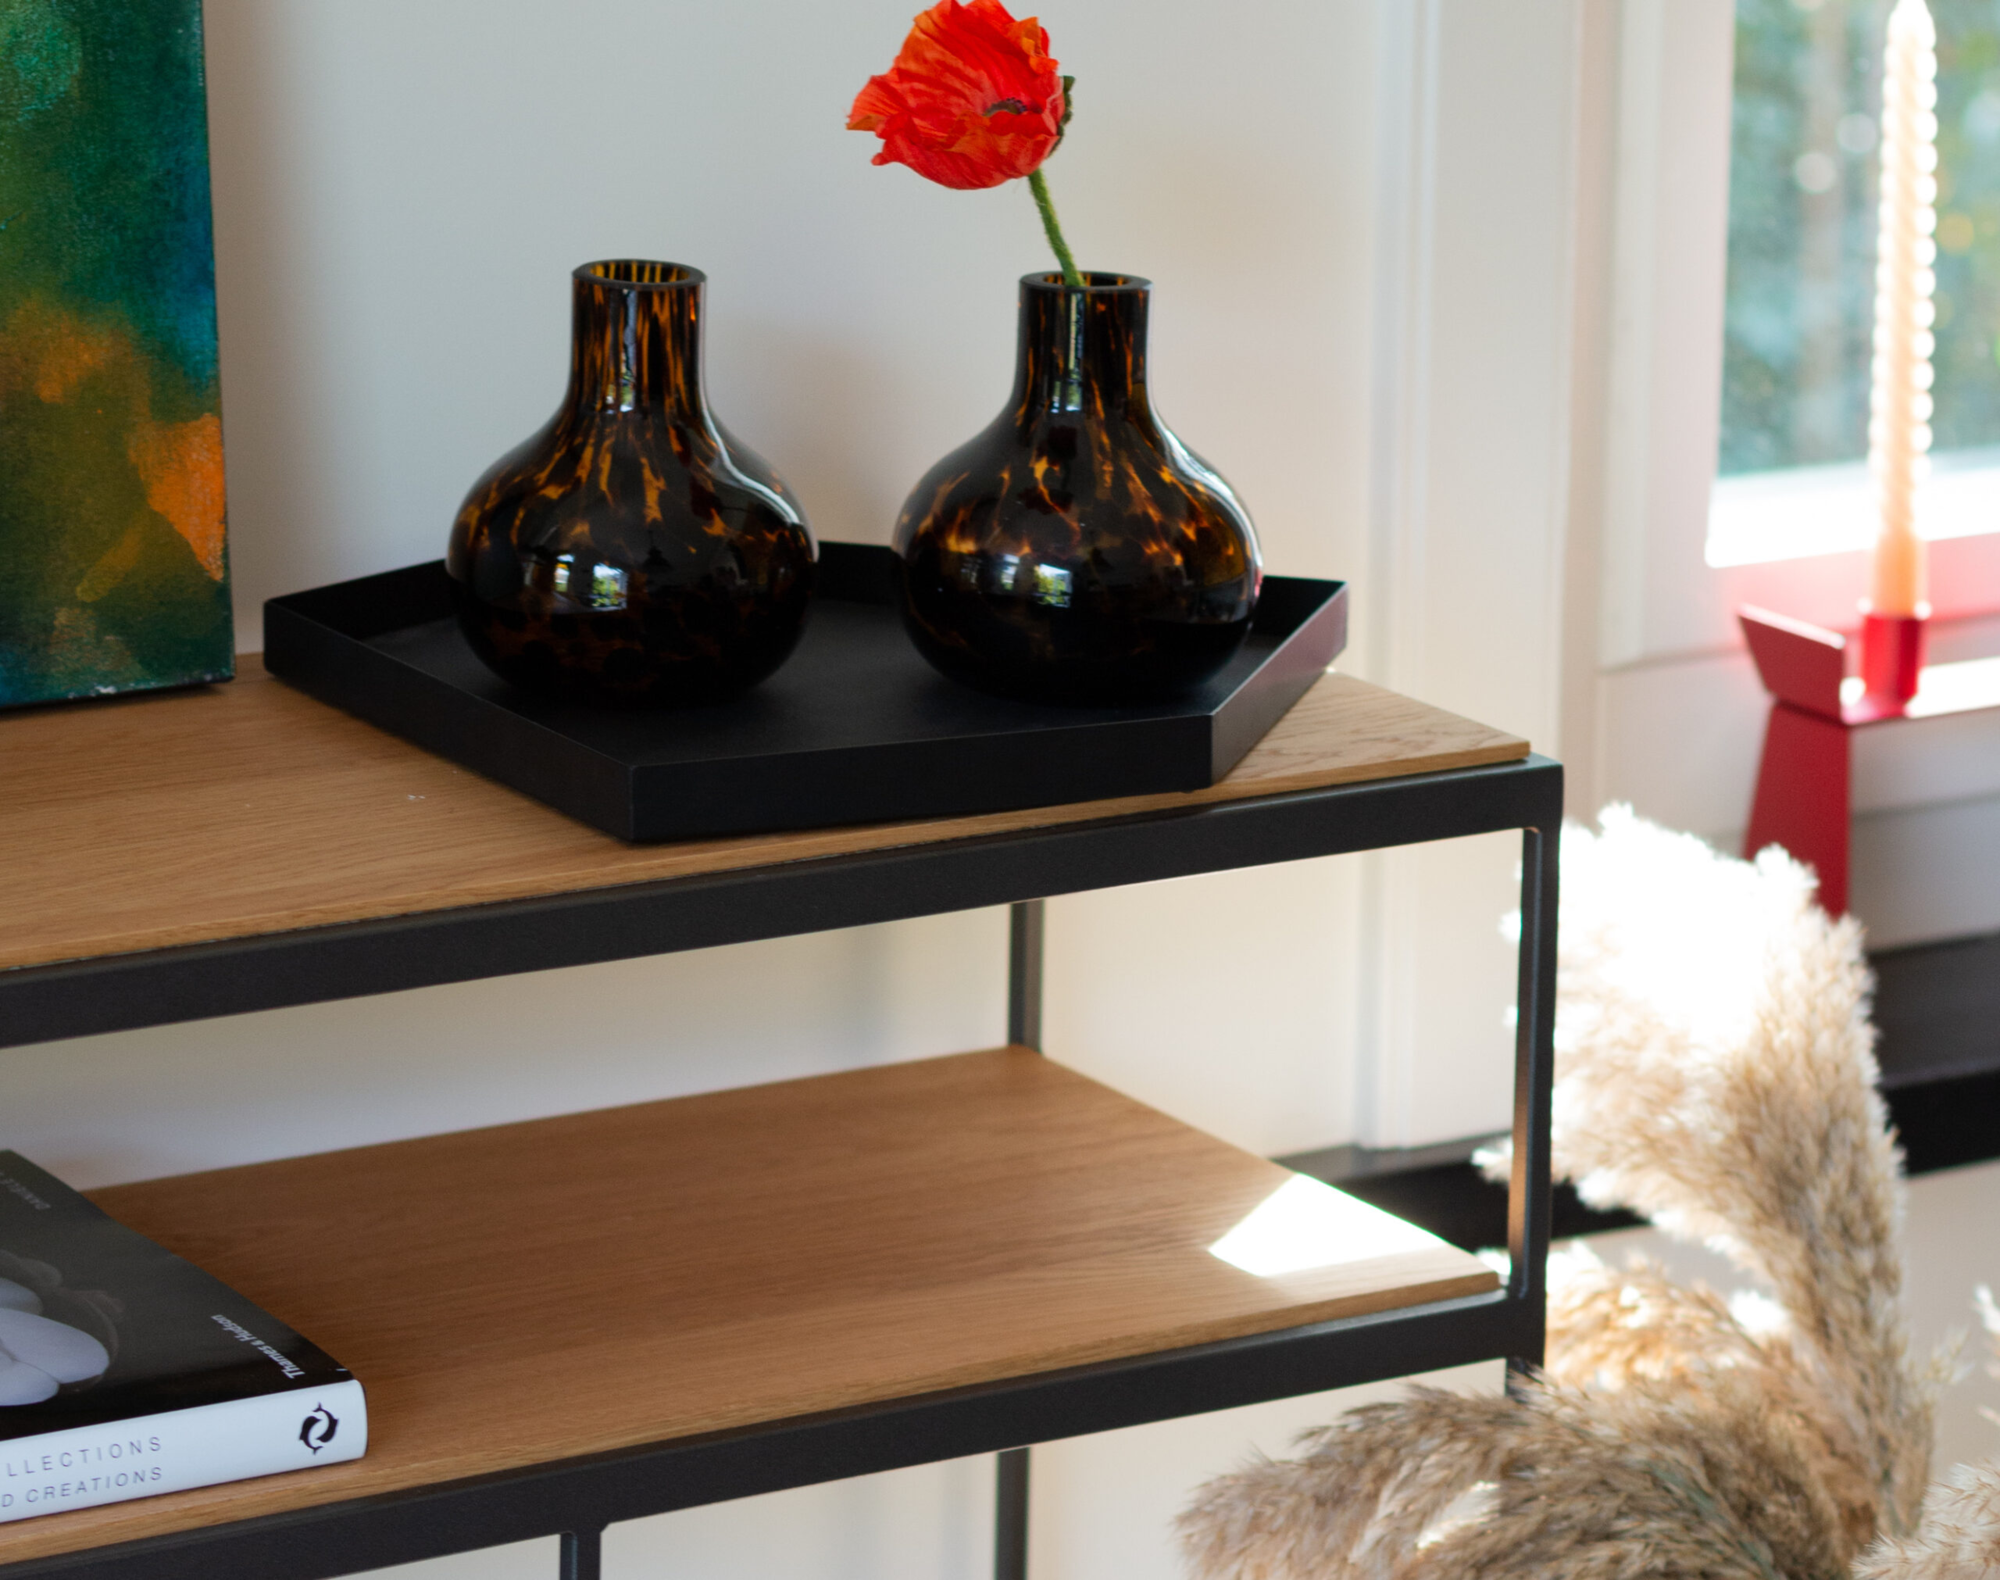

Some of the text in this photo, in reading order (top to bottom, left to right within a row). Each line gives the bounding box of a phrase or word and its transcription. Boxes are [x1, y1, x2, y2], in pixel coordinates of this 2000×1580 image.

[210, 1314, 257, 1342] Hudson
[257, 1345, 305, 1379] Thames
[6, 1436, 161, 1477] LLECTIONS
[25, 1466, 162, 1503] CREATIONS
